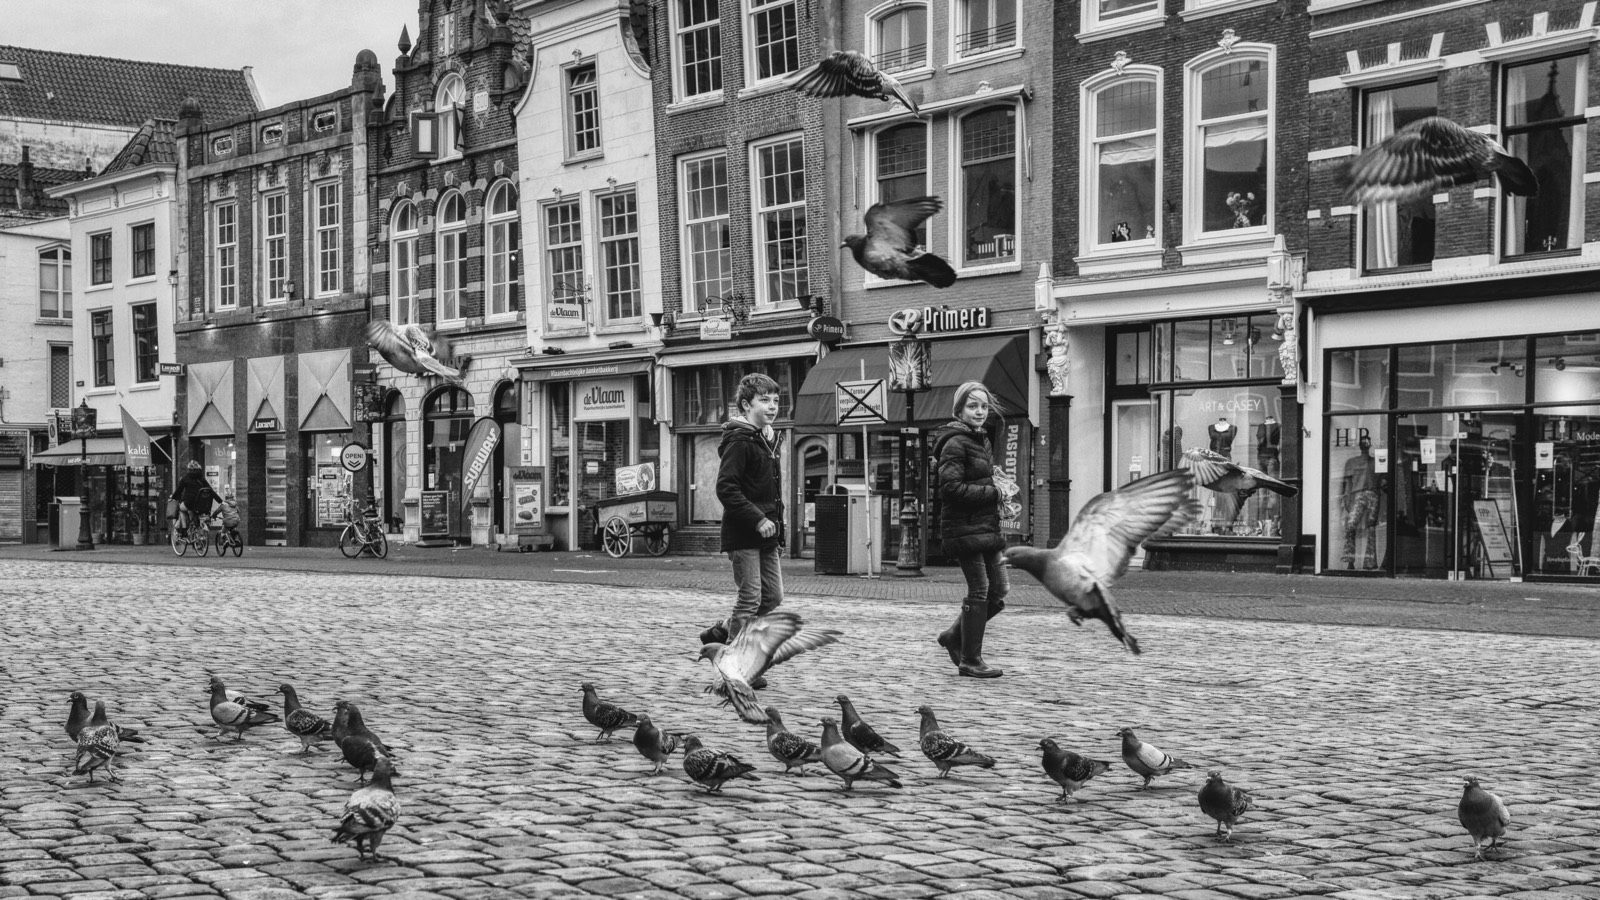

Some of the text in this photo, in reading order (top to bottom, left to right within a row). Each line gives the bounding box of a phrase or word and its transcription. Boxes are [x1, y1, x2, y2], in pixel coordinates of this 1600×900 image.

[924, 305, 987, 332] Primera
[823, 324, 844, 334] Primera
[1200, 399, 1261, 412] ART & CASEY
[127, 445, 150, 456] kaldi
[464, 427, 498, 490] SUBWAY
